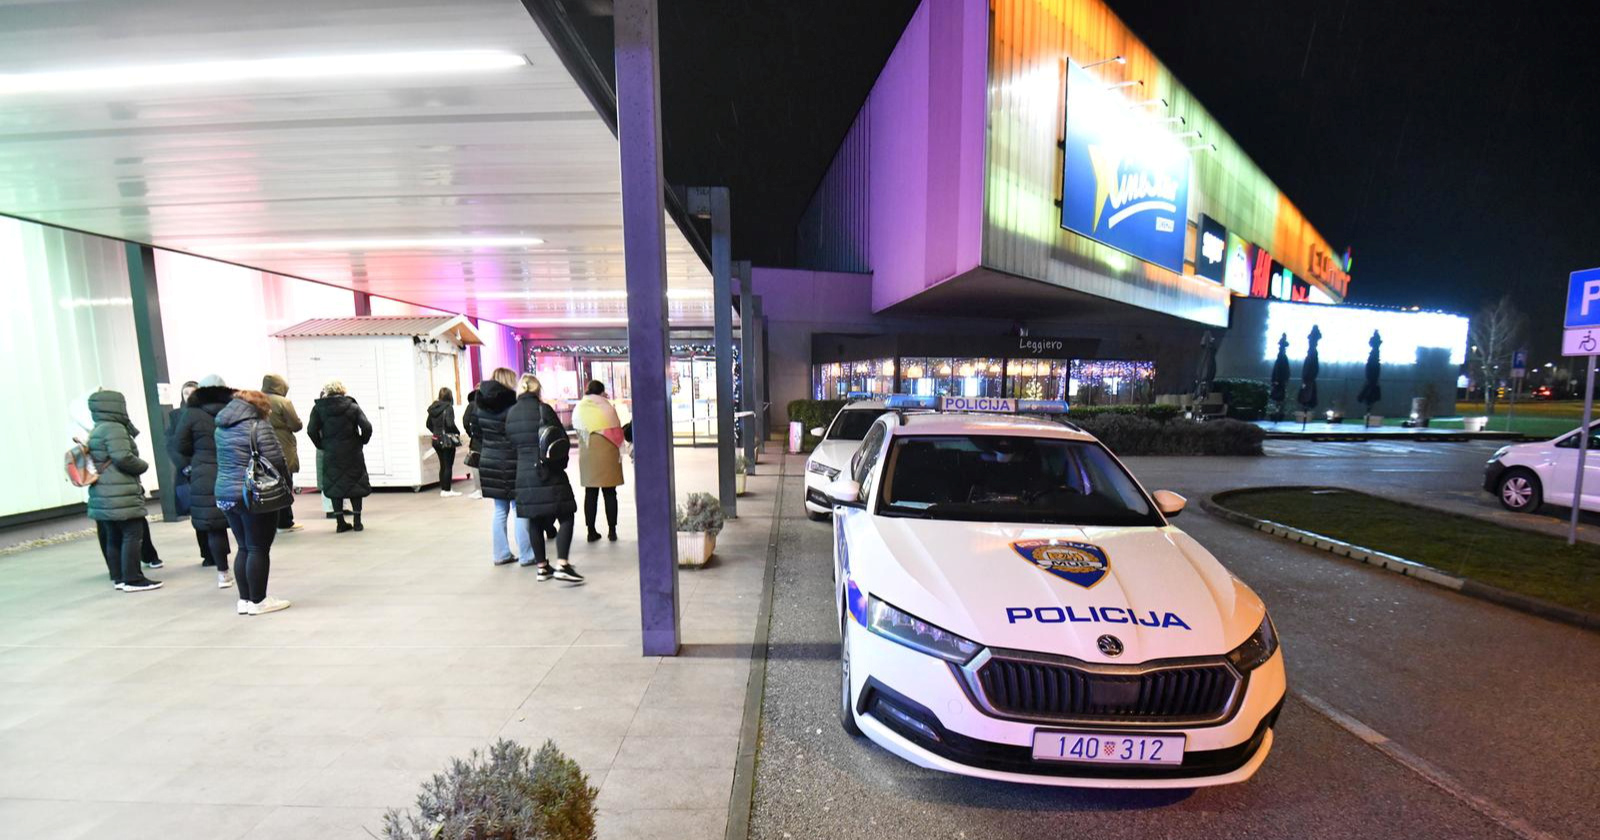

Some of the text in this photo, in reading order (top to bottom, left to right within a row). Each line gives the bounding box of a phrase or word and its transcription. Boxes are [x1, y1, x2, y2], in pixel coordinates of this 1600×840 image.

[1580, 279, 1600, 316] P
[1019, 337, 1063, 354] Leggiero
[945, 397, 1010, 412] POLICIJA
[1016, 540, 1099, 551] POLCIJA
[1006, 605, 1192, 631] POLICIJA
[1059, 736, 1164, 761] 140 312
